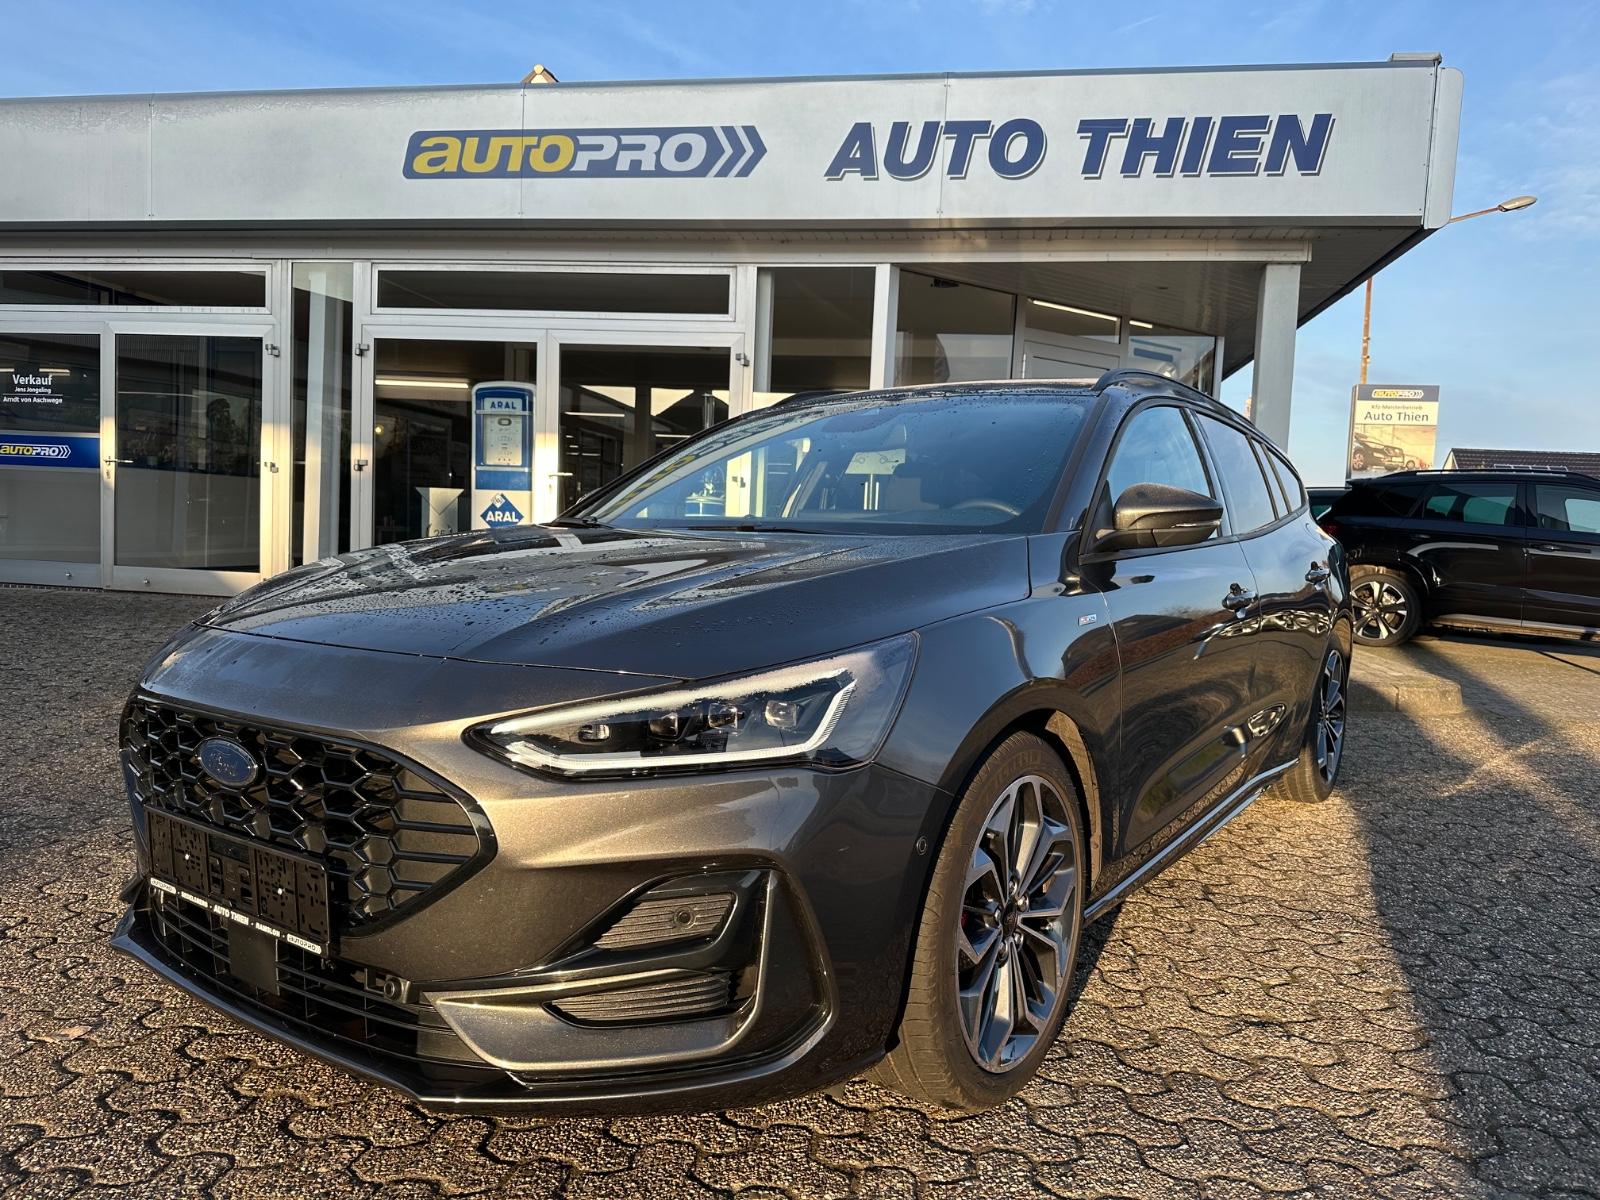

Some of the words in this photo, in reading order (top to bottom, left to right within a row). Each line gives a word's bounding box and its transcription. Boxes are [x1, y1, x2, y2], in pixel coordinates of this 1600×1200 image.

[823, 118, 1048, 182] AUTO
[1076, 113, 1336, 180] THIEN
[12, 374, 52, 385] Verkauf
[490, 401, 517, 410] ARAL
[1364, 411, 1393, 421] Auto
[1397, 412, 1429, 422] Thien
[486, 511, 519, 522] ARAL
[213, 904, 230, 918] AUTO
